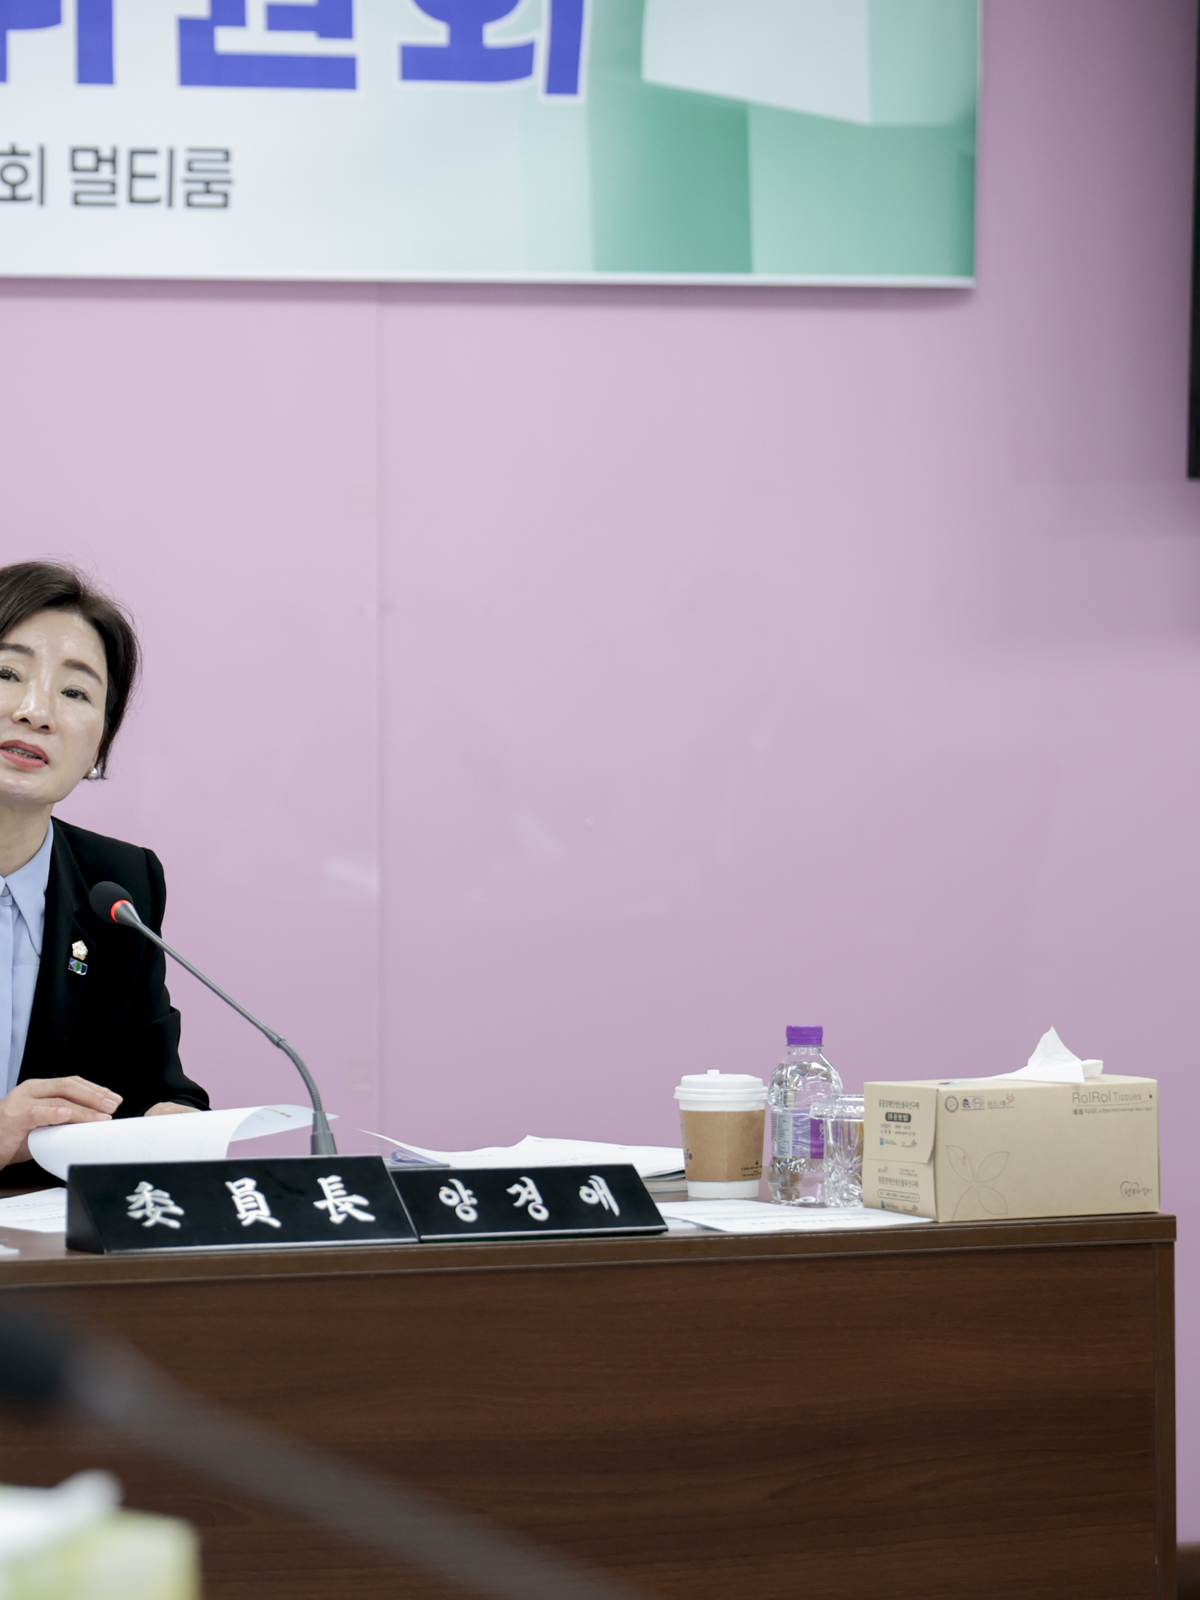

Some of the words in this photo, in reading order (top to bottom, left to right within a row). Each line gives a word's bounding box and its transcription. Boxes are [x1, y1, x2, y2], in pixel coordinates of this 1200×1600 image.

[69, 146, 233, 210] 멀티룸
[1113, 1091, 1142, 1101] Tissues
[125, 1173, 377, 1230] 委員長
[437, 1174, 622, 1224] 양경애
